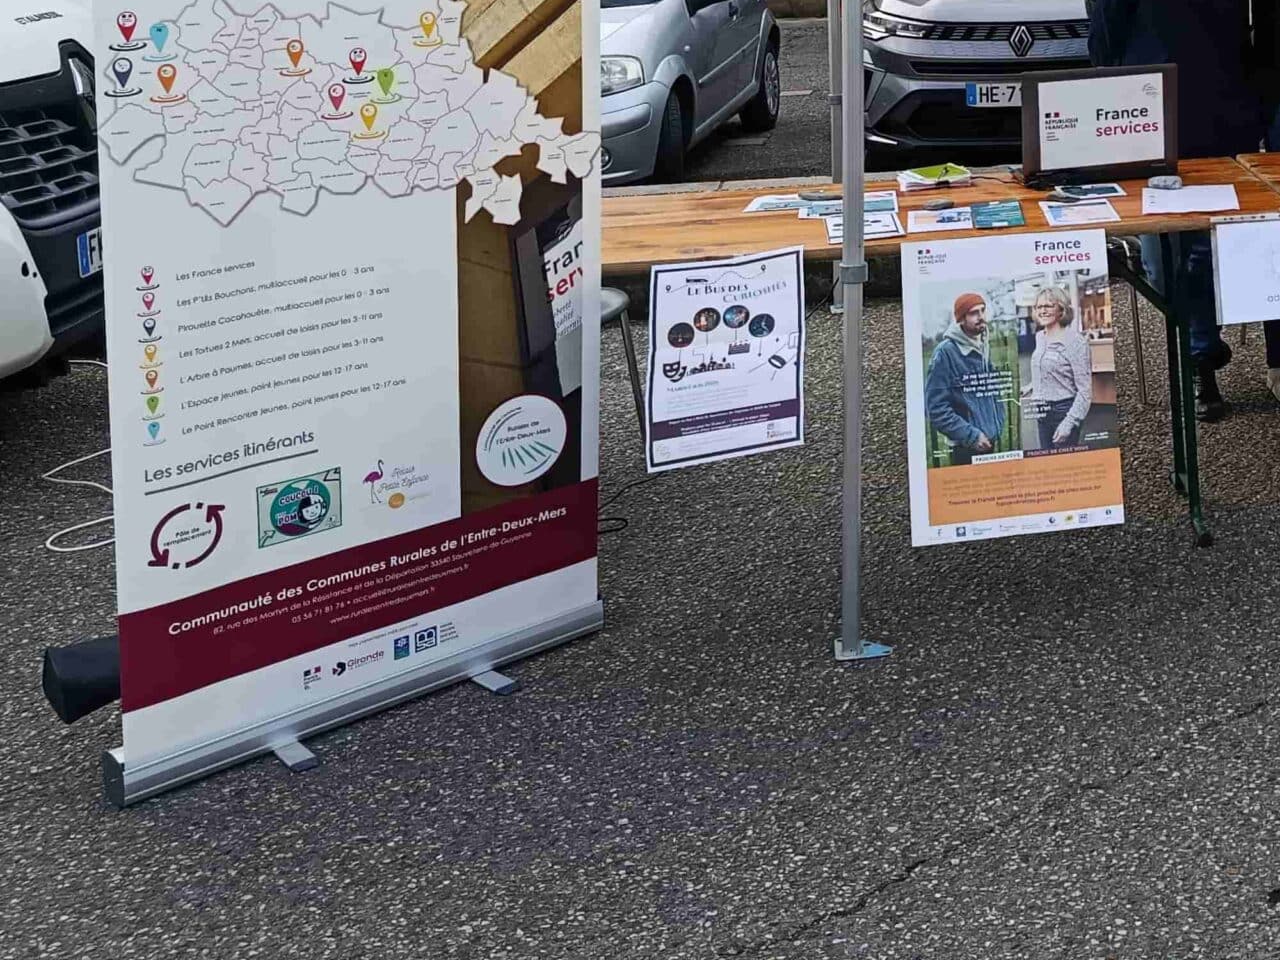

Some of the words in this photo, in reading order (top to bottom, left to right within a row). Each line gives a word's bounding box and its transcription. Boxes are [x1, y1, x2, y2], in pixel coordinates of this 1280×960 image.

[1096, 107, 1149, 121] France
[1095, 120, 1159, 137] services
[1034, 239, 1081, 252] France
[1034, 250, 1091, 265] services
[176, 273, 190, 281] Les
[177, 299, 191, 307] Les
[309, 273, 329, 283] pour
[329, 270, 340, 279] les
[341, 269, 347, 277] 0
[353, 267, 359, 275] 3
[360, 265, 375, 274] ans
[178, 320, 216, 333] Pirouette
[324, 295, 343, 305] pour
[344, 292, 355, 301] les
[356, 290, 362, 298] 0
[369, 288, 375, 296] 3
[375, 287, 390, 295] ans
[179, 350, 193, 358] Les
[194, 343, 223, 355] Tortues
[224, 340, 231, 349] 2
[254, 329, 285, 342] accueil
[286, 327, 298, 336] de
[321, 319, 340, 330] pour
[340, 317, 351, 325] les
[368, 312, 383, 320] ans
[211, 368, 218, 377] à
[255, 354, 286, 366] accueil
[288, 351, 299, 360] de
[322, 343, 341, 354] pour
[341, 341, 352, 349] les
[354, 338, 368, 347] 3-11
[369, 336, 384, 344] ans
[250, 381, 271, 393] point
[273, 376, 300, 389] jeunes
[302, 373, 321, 383] pour
[321, 369, 333, 377] les
[354, 362, 368, 370] ans
[181, 426, 193, 435] Le
[194, 420, 215, 431] Point
[216, 410, 258, 426] Rencontre
[291, 397, 313, 409] point
[314, 392, 339, 405] jeunes
[340, 388, 359, 399] pour
[360, 385, 371, 393] les
[372, 380, 391, 391] 12-17
[144, 466, 172, 483] Les
[176, 449, 240, 476] services
[243, 431, 315, 458] itinérants
[279, 488, 312, 506] COUCOU
[163, 529, 212, 547] remplacement
[175, 528, 191, 539] Pôle
[191, 526, 200, 534] de
[168, 591, 273, 635] Communauté
[276, 585, 303, 601] des
[306, 561, 386, 592] Communes
[390, 544, 437, 568] Rurales
[440, 538, 457, 552] de
[460, 506, 567, 547] l'Entre-Deux-Mers
[226, 621, 241, 631] rue
[243, 615, 258, 625] des
[290, 602, 301, 611] de
[302, 599, 311, 608] la
[312, 586, 353, 603] Résistance
[354, 584, 362, 592] et
[363, 580, 374, 588] de
[375, 576, 384, 585] la
[385, 563, 429, 582] Déportation
[347, 649, 385, 668] Gironde
